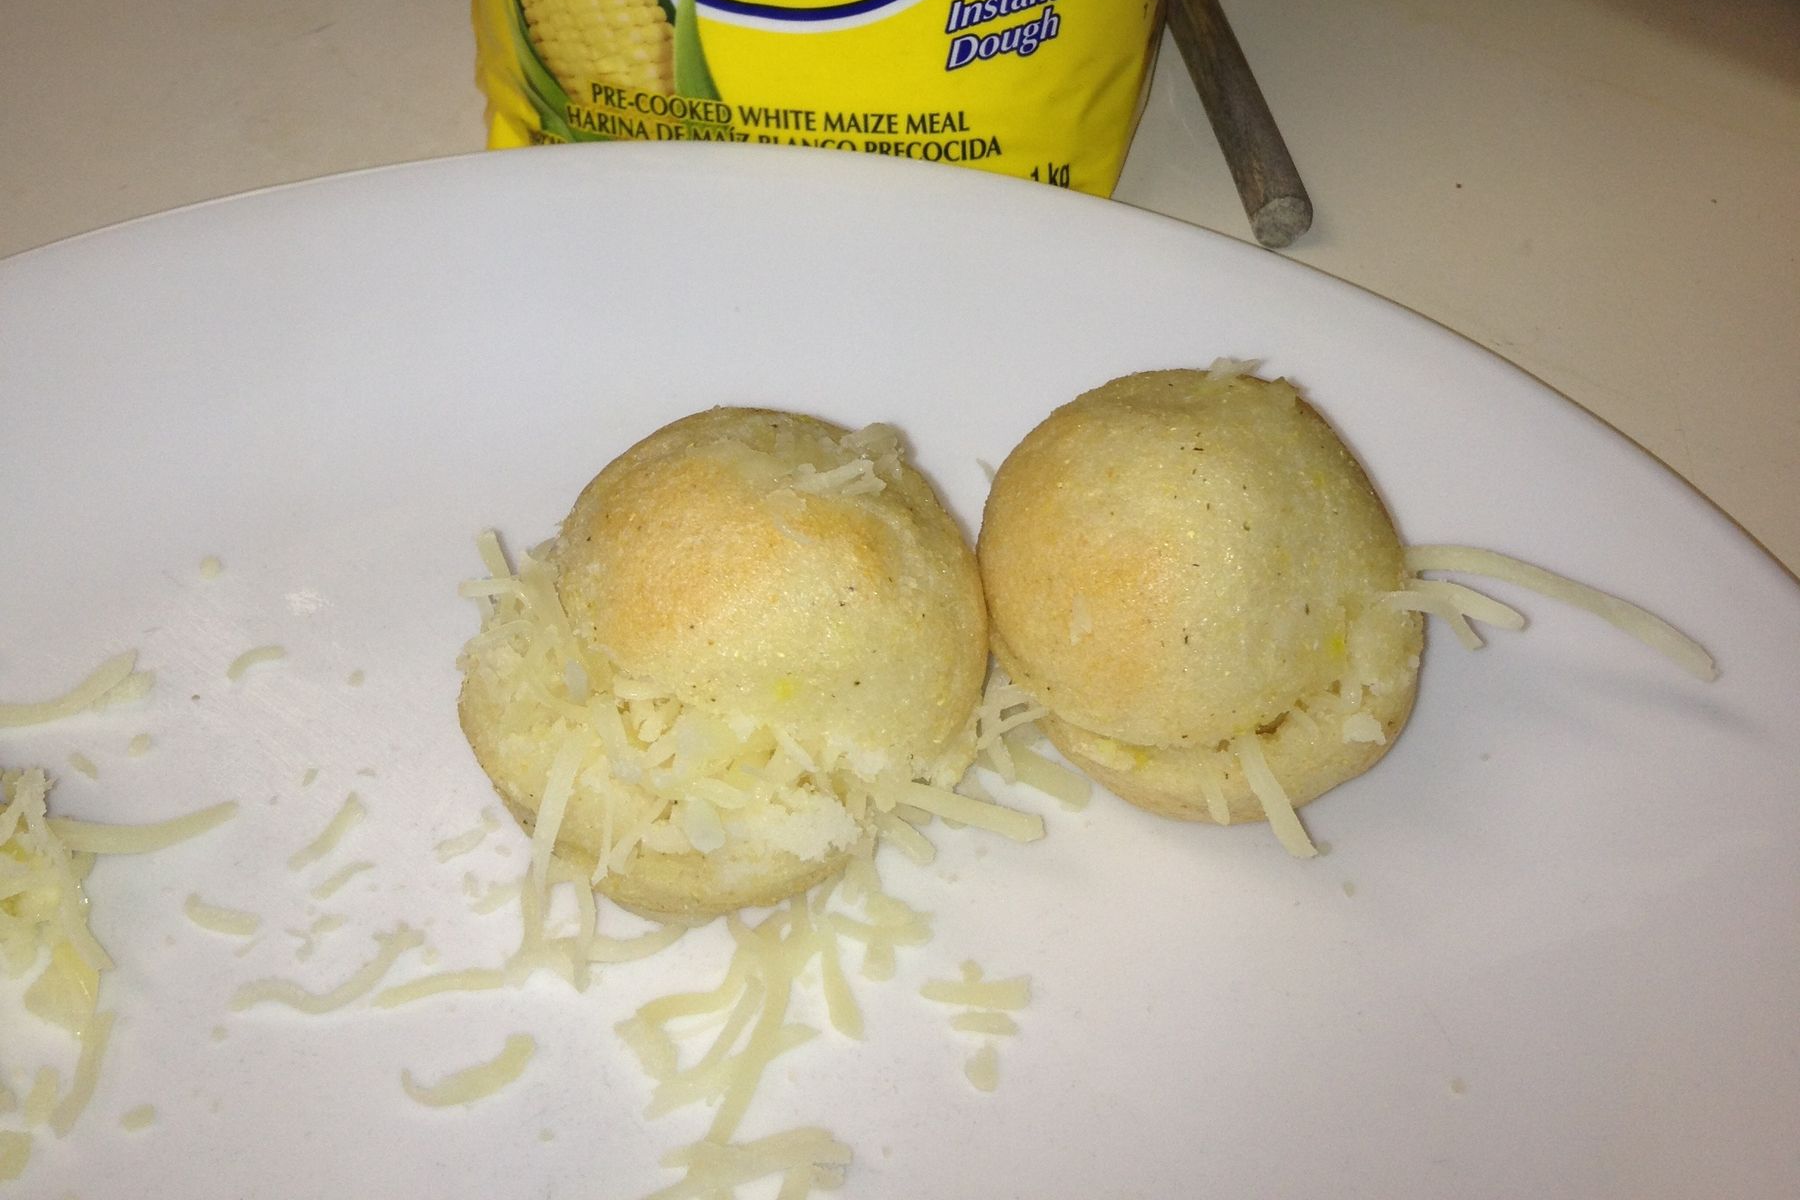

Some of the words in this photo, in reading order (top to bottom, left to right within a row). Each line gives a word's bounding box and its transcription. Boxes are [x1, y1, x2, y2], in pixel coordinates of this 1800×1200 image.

[946, 5, 1060, 71] Dough
[567, 105, 649, 141] HARINA
[656, 123, 685, 141] DE
[864, 135, 1003, 162] PRECOCIDA
[591, 83, 733, 125] PRE-COOKED
[738, 105, 817, 133] WHITE
[823, 112, 899, 134] MAIZE
[905, 110, 970, 134] MEAL
[1030, 166, 1039, 182] 1
[1048, 162, 1070, 189] kg
